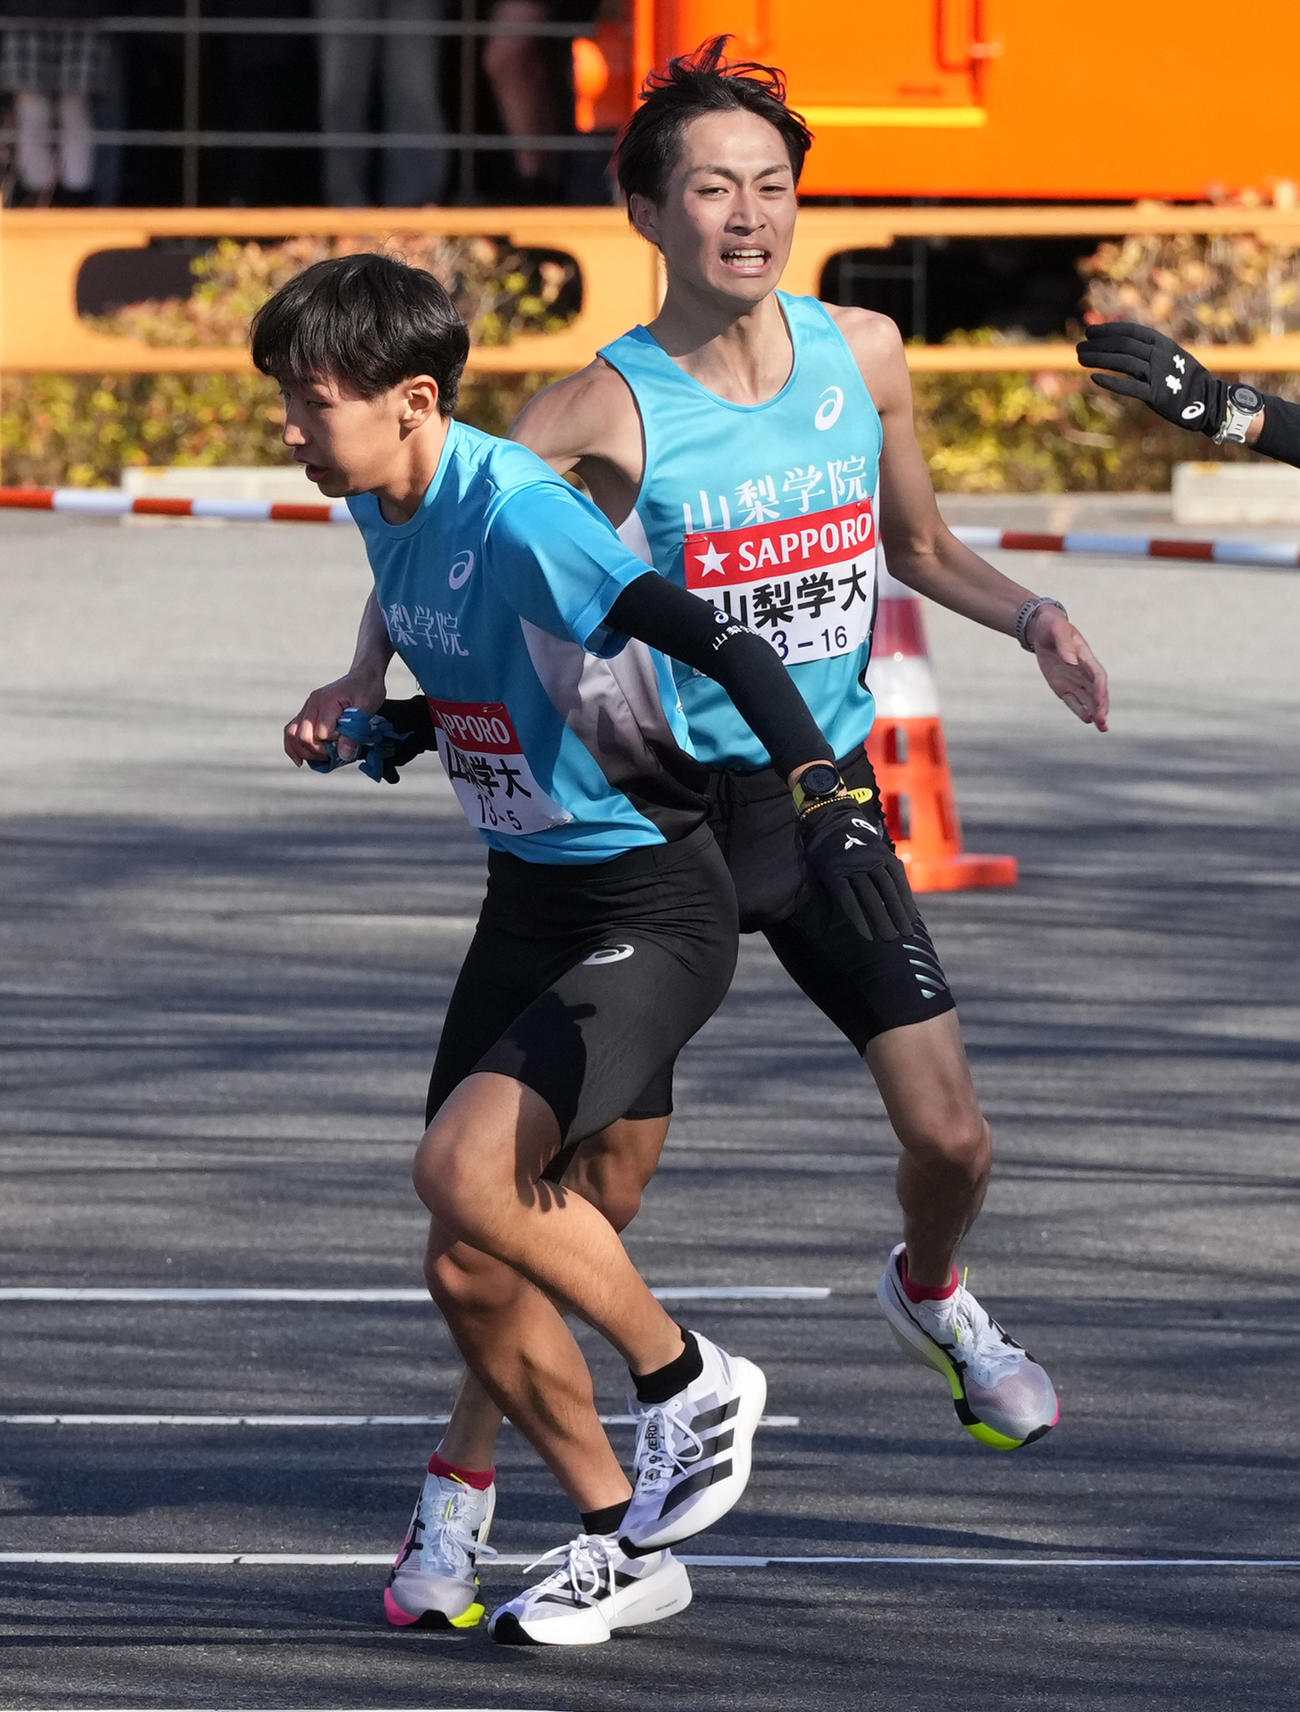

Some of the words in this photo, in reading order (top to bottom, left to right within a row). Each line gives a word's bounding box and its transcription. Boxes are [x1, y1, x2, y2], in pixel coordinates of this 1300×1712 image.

[682, 456, 868, 535] 山梨学院
[738, 512, 872, 572] SAPPORO
[381, 603, 470, 657] 梨学院
